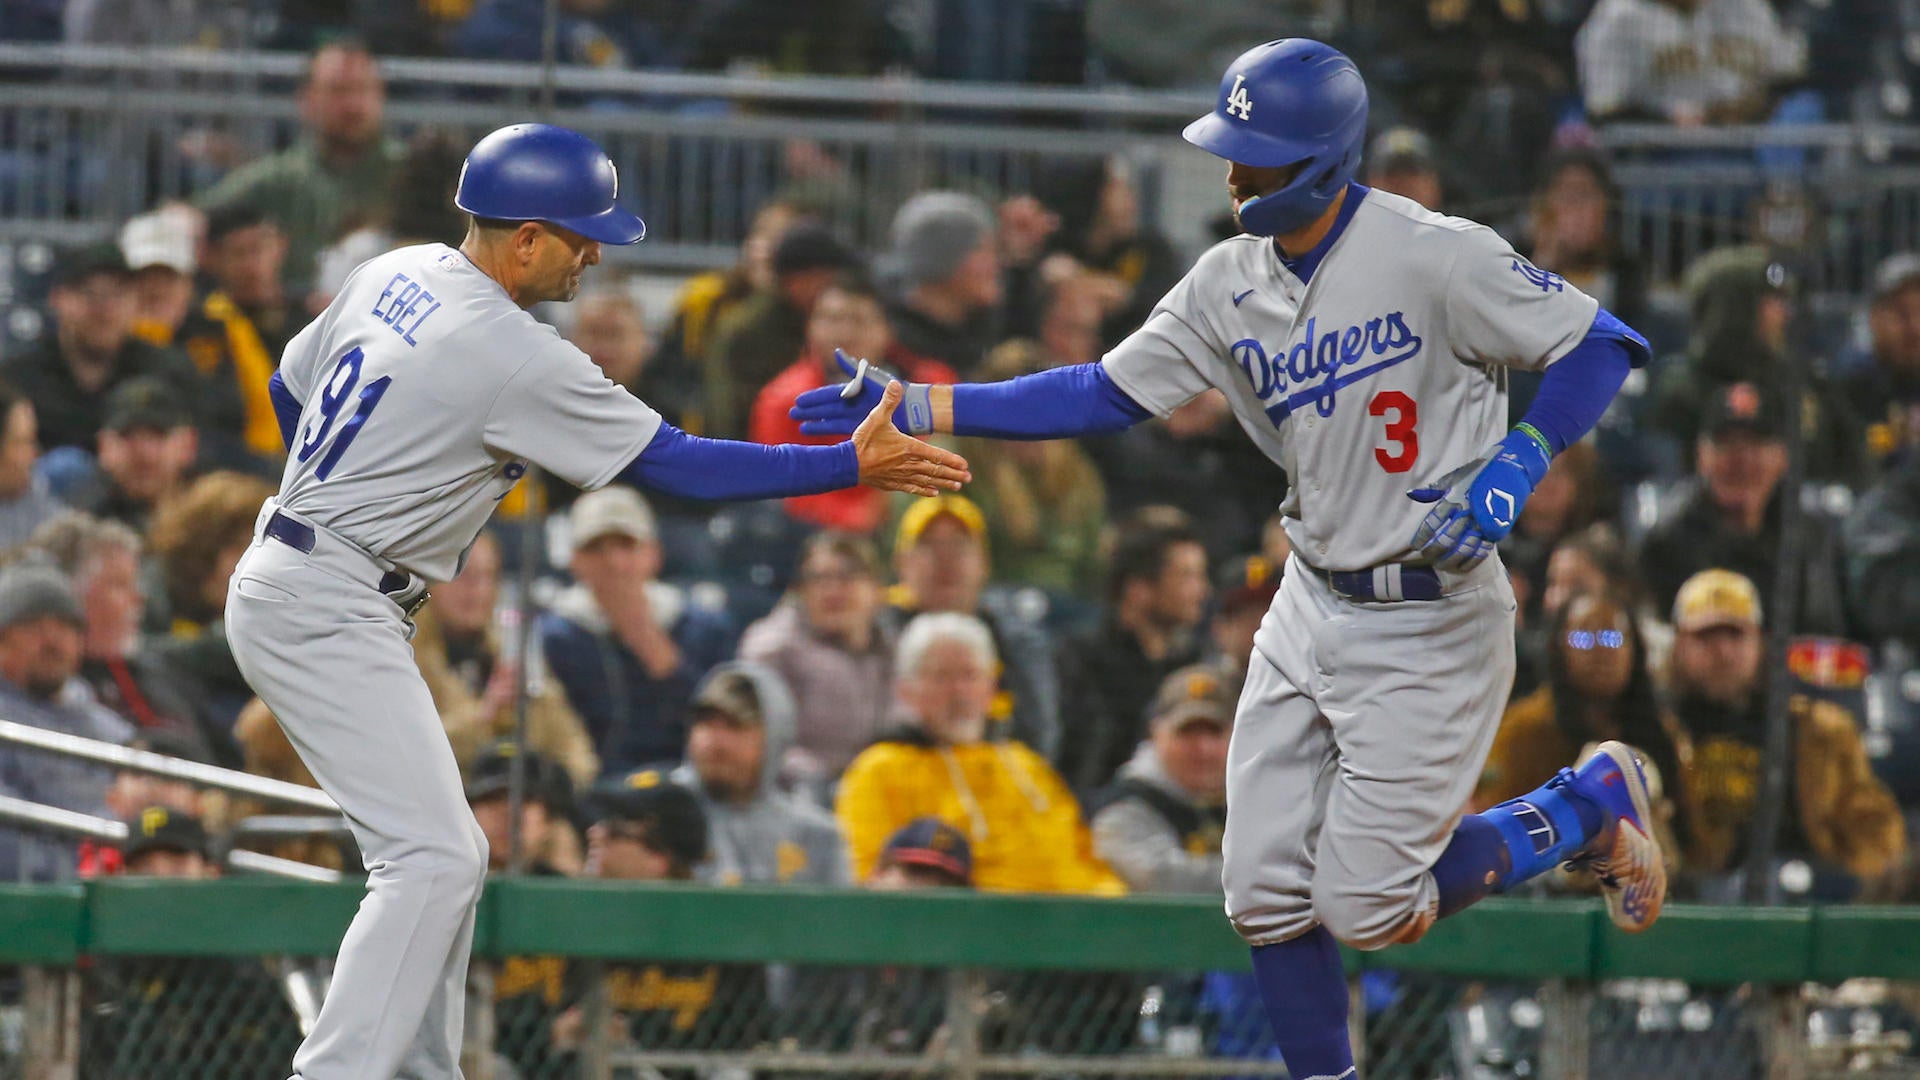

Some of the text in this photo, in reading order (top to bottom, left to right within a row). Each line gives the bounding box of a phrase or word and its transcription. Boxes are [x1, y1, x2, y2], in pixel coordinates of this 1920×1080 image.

[1226, 74, 1253, 121] LA
[371, 272, 441, 347] EBEL
[1231, 311, 1422, 422] Dodgers
[298, 346, 392, 482] 91
[1369, 391, 1419, 474] 3
